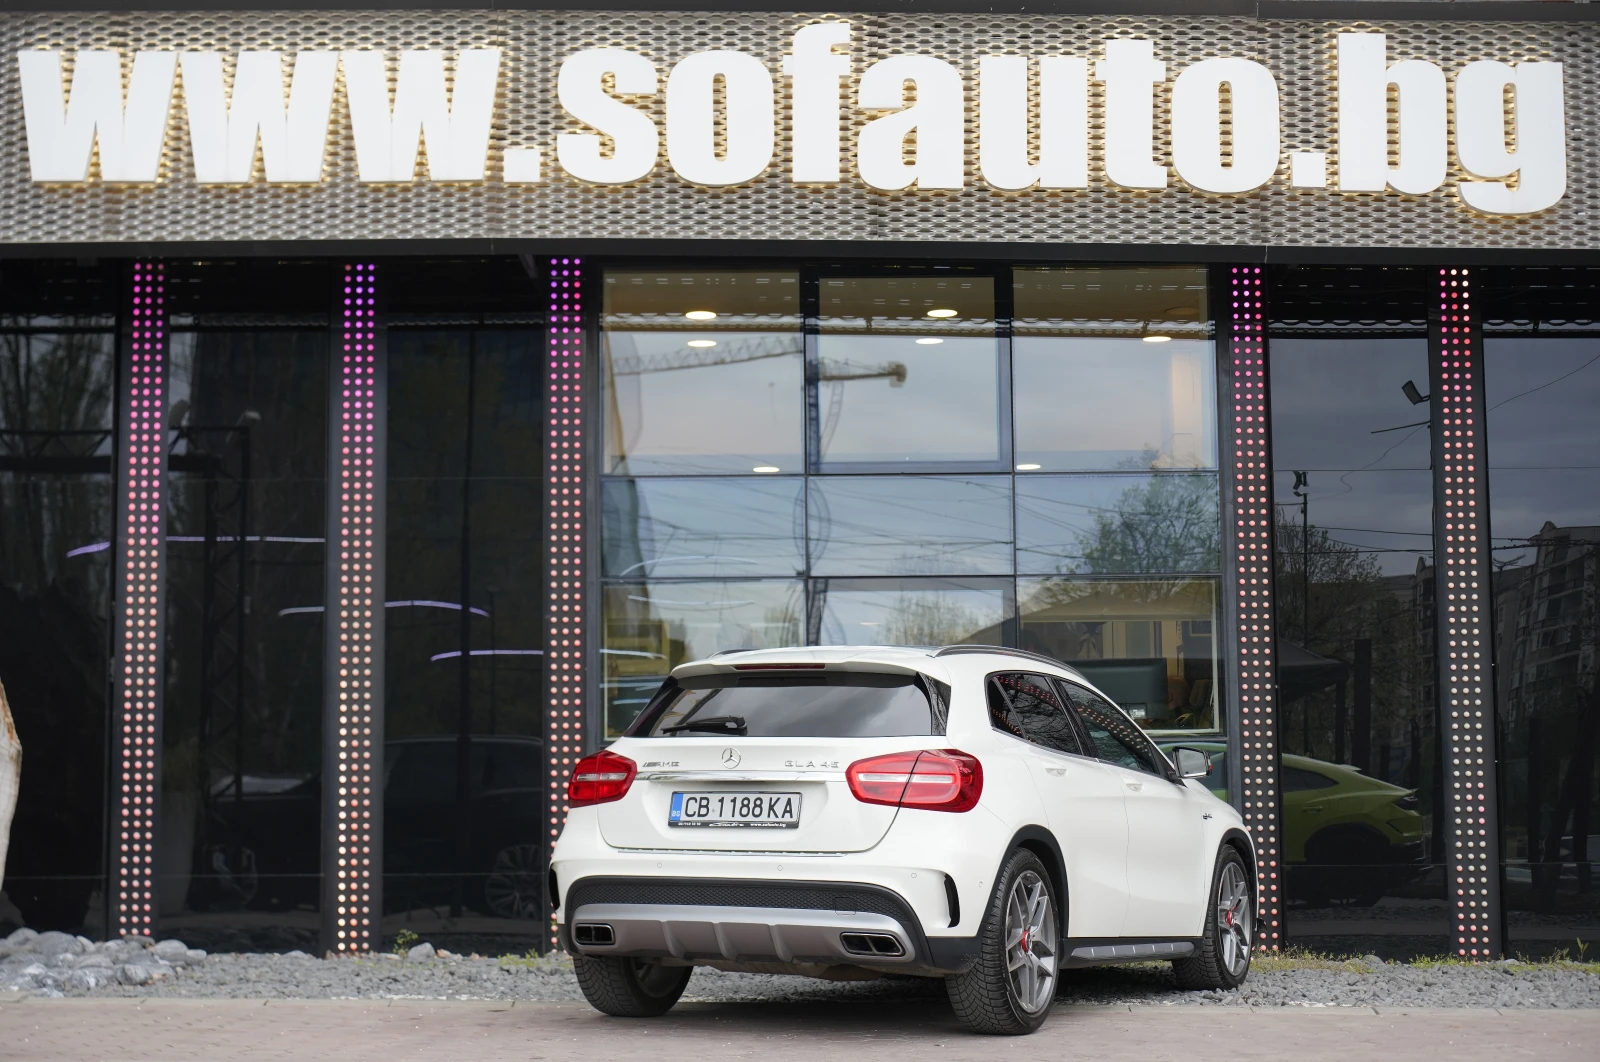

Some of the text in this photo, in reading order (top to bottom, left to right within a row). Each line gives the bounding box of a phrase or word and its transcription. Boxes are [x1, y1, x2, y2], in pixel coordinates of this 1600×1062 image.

[17, 23, 1567, 214] www.sofauto.bg
[784, 760, 840, 769] GLA 45
[717, 796, 764, 818] 1188
[767, 796, 794, 819] KA
